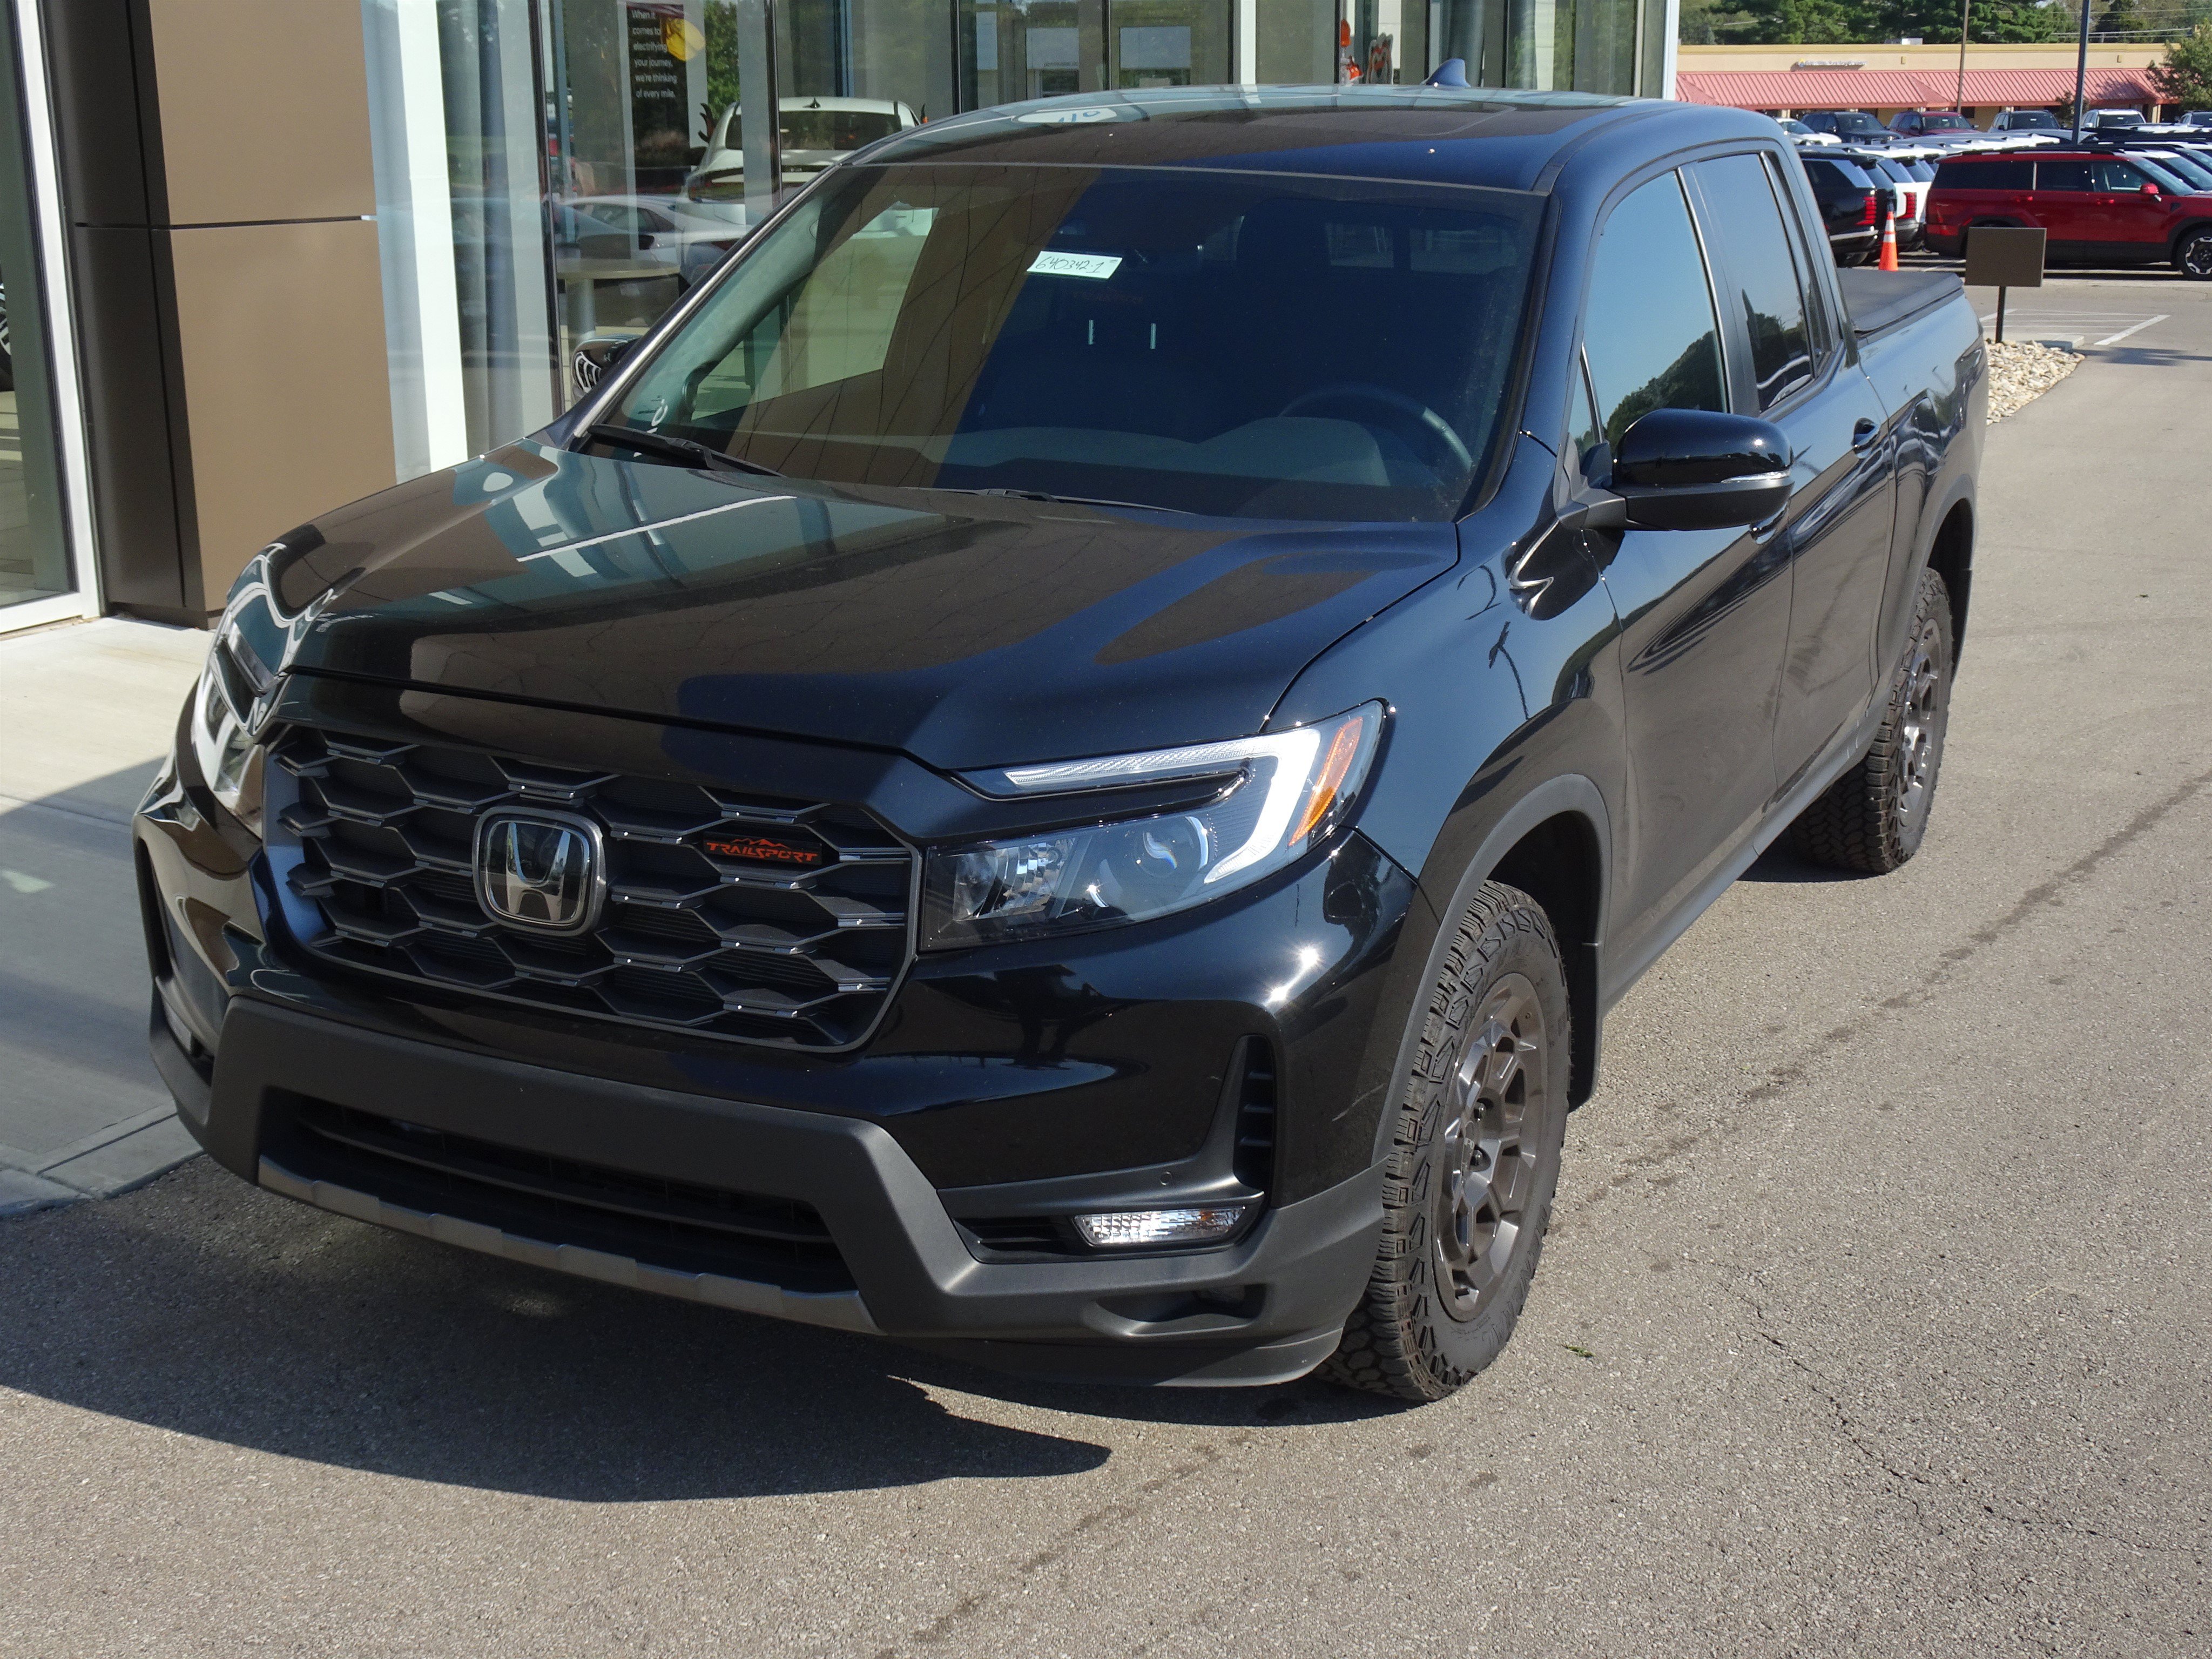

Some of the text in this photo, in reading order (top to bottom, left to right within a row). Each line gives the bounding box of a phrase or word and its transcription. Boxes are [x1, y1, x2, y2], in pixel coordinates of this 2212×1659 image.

[631, 10, 650, 18] When
[654, 26, 661, 35] to
[633, 42, 667, 52] electrifying
[634, 59, 648, 68] your
[652, 72, 677, 84] thinking
[635, 87, 643, 98] of
[643, 90, 659, 99] every
[706, 842, 818, 862] TRAILSPORT
